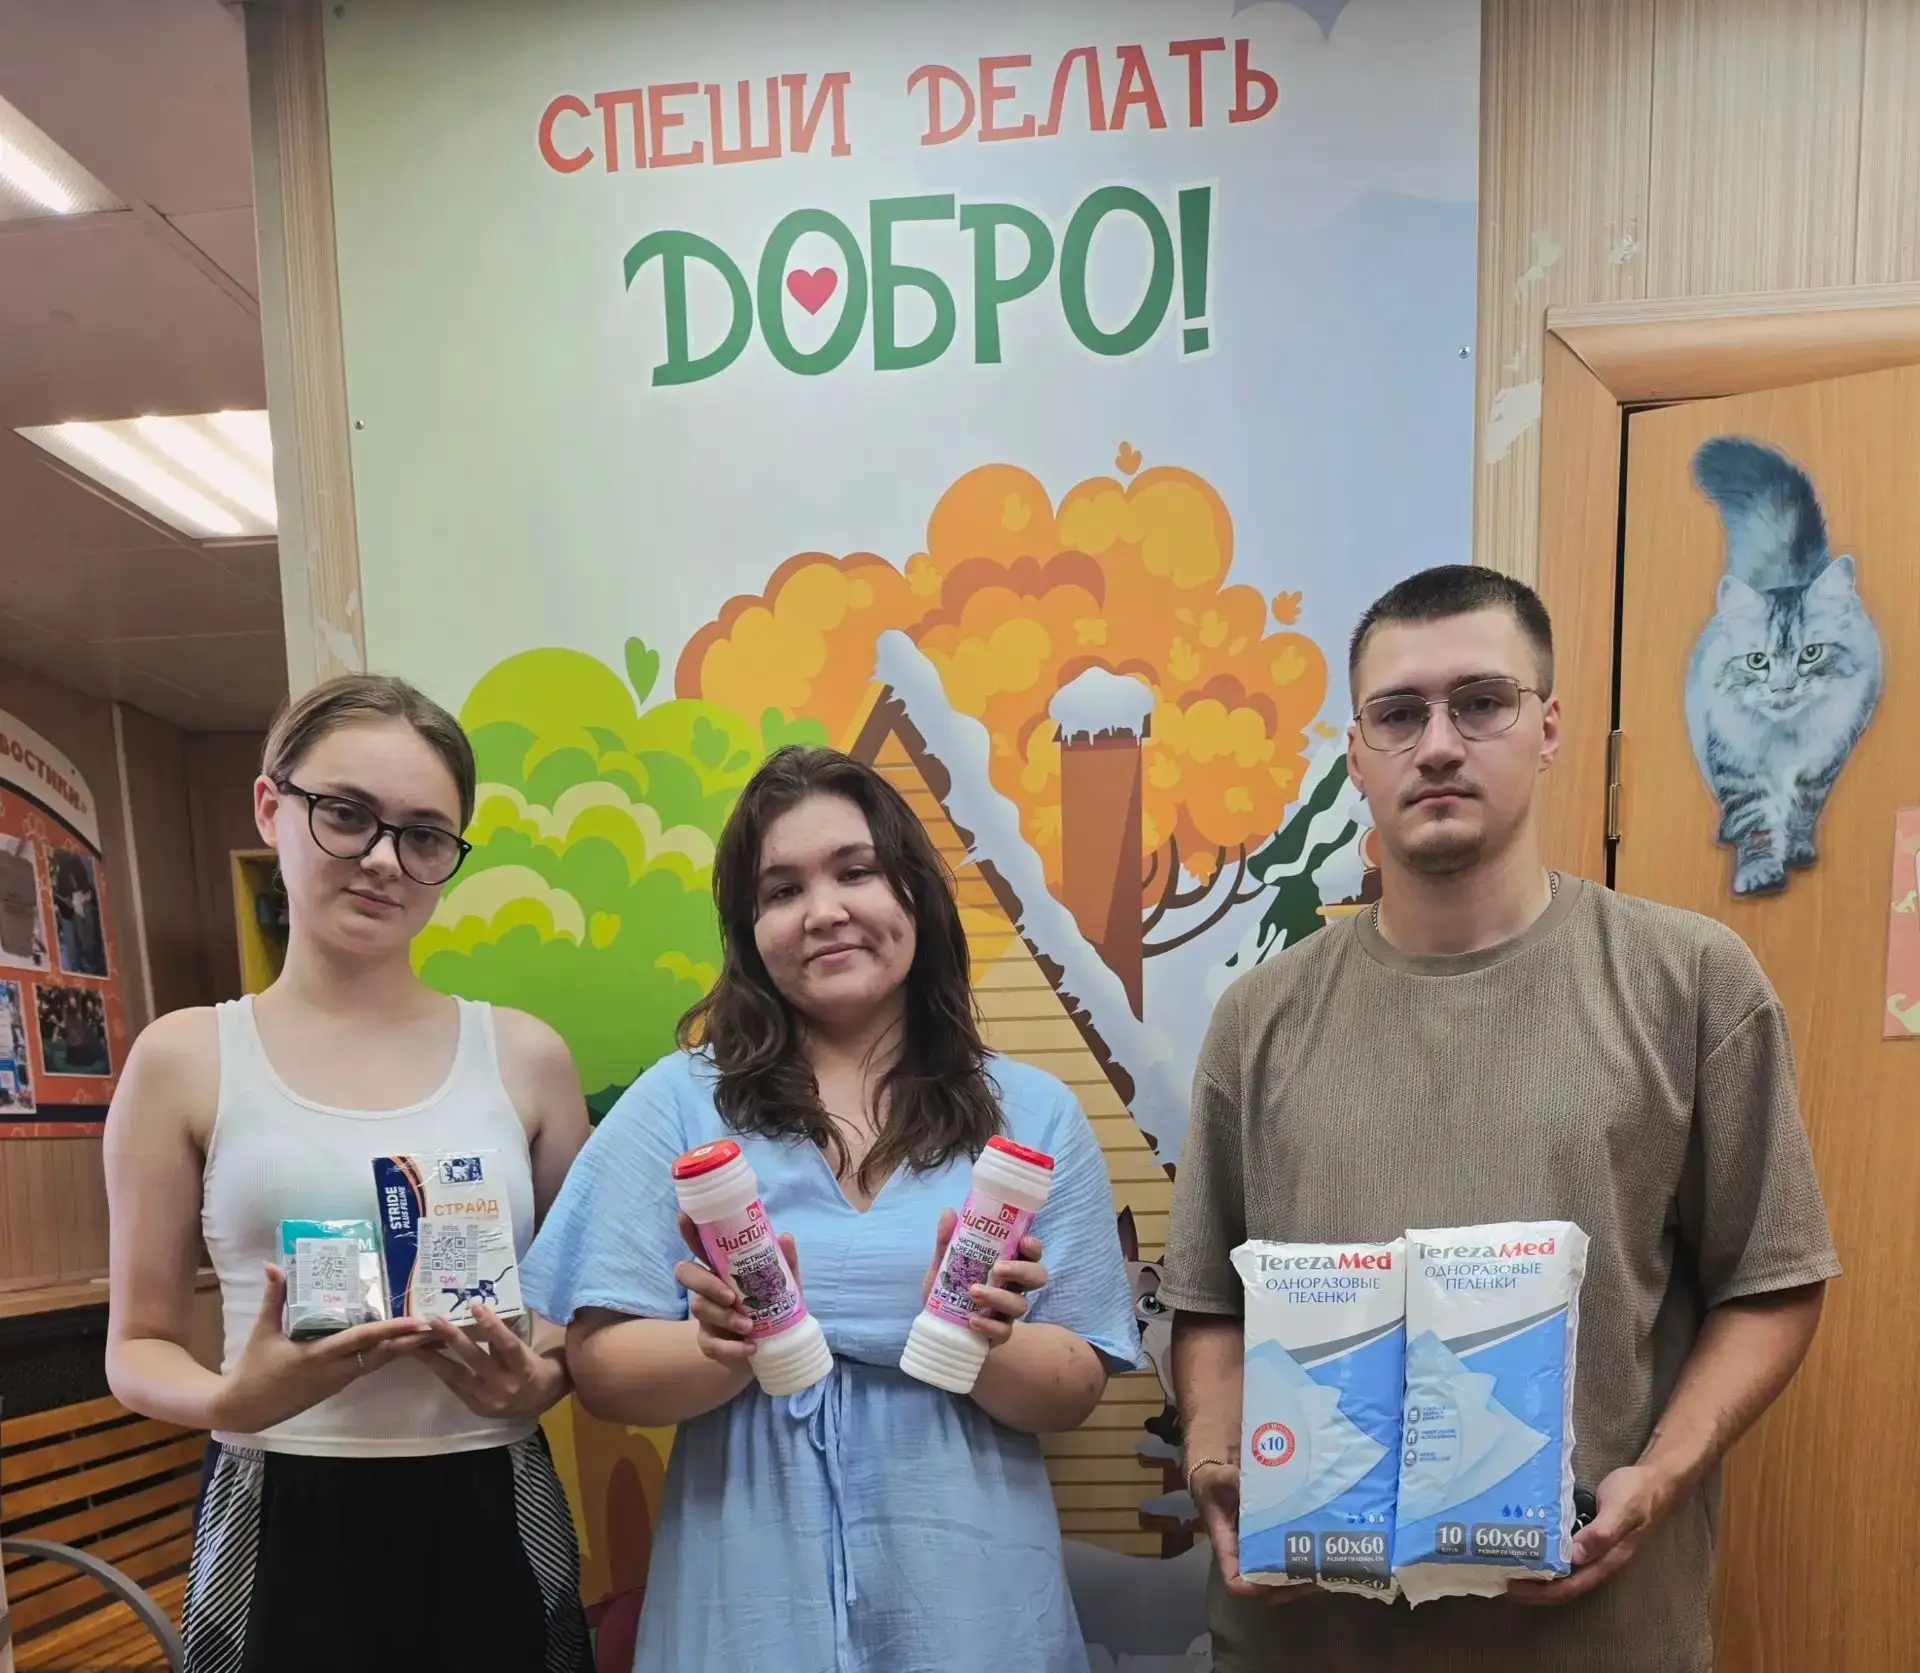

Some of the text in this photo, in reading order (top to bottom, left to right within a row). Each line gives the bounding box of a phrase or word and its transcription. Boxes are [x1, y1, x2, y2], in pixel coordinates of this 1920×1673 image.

[537, 37, 1279, 174] СПЕШИ ДЕЛАТЬ
[623, 186, 1211, 387] ДОБРО!
[385, 1186, 402, 1230] STRIDE
[398, 1186, 411, 1229] PLUS FELINE
[434, 1198, 499, 1216] СТРАЙД
[1415, 1237, 1556, 1259] TerezaMed
[1256, 1251, 1392, 1272] TerezaMed
[1425, 1262, 1542, 1278] ОДНОРАЗОВЫЕ
[1266, 1277, 1380, 1291] ОДНОРАЗОВЫЕ
[1446, 1277, 1516, 1290] ПЕЛЕНКИ
[1289, 1291, 1356, 1303] ПЕЛЕНКИ
[1440, 1526, 1462, 1544] 10
[1476, 1528, 1540, 1549] 60x60
[1287, 1536, 1311, 1554] 10
[1325, 1536, 1384, 1554] 60x60
